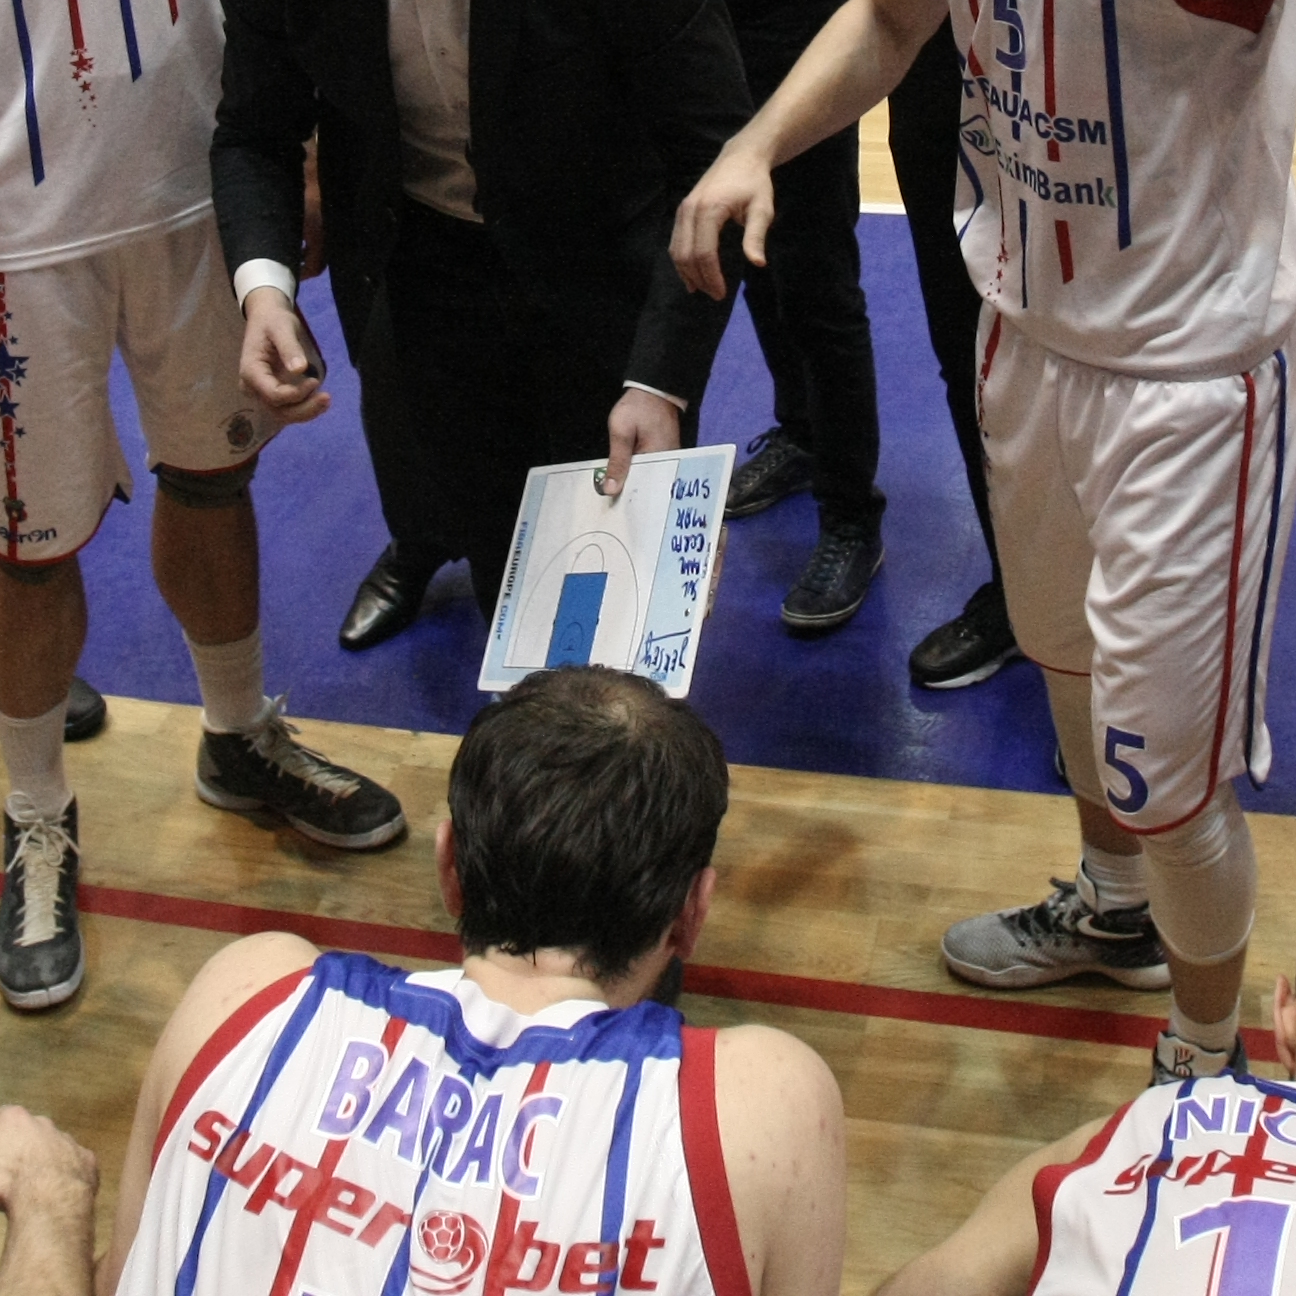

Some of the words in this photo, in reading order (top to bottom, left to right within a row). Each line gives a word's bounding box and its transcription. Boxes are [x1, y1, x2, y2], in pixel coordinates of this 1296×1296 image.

[1035, 112, 1108, 146] CSM
[1104, 725, 1149, 814] 5
[314, 1035, 569, 1202] BARAC
